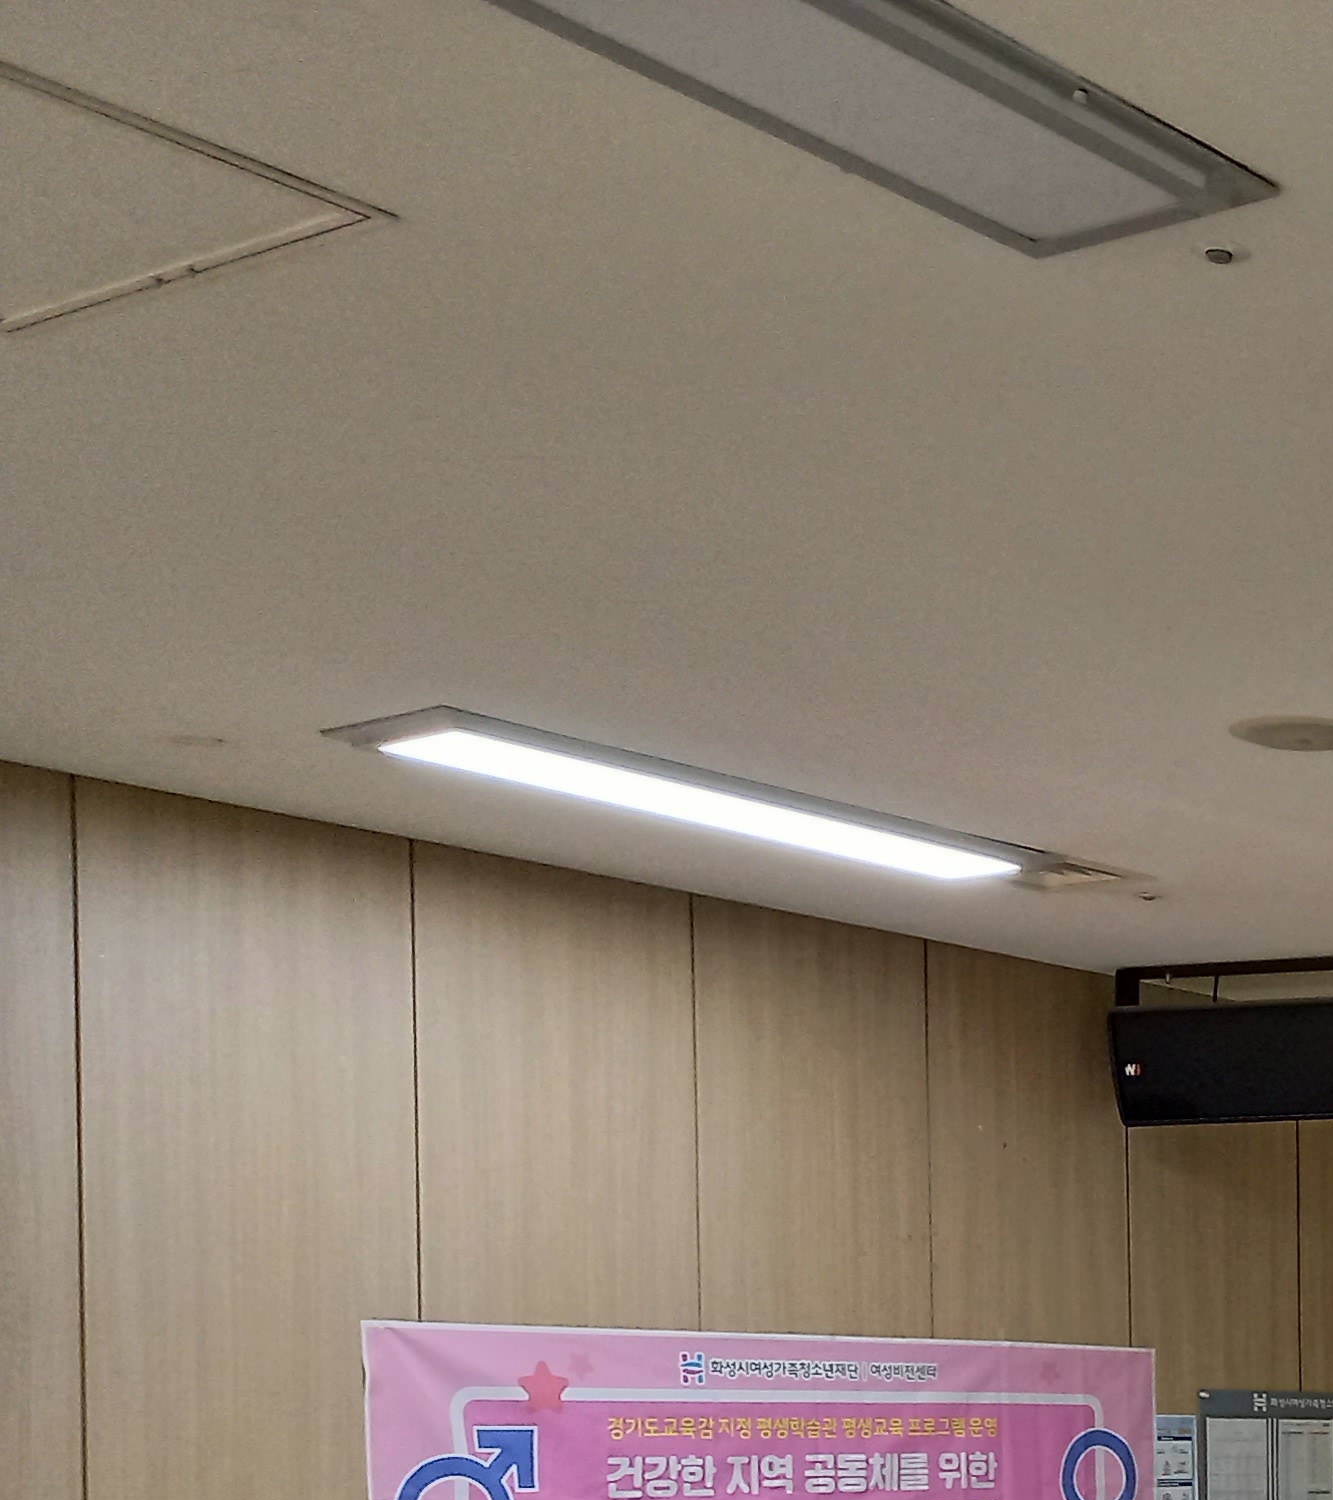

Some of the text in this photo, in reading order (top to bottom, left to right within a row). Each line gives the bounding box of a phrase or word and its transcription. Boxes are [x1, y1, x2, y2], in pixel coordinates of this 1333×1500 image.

[710, 1360, 938, 1381] 화성시여성가족청소년재단 여성비전센터
[607, 1416, 998, 1440] 경기도교육감 지정 평생학습관 평생교육 프로그램 운영
[605, 1451, 998, 1499] 건강한 지역 공동체를 위한
